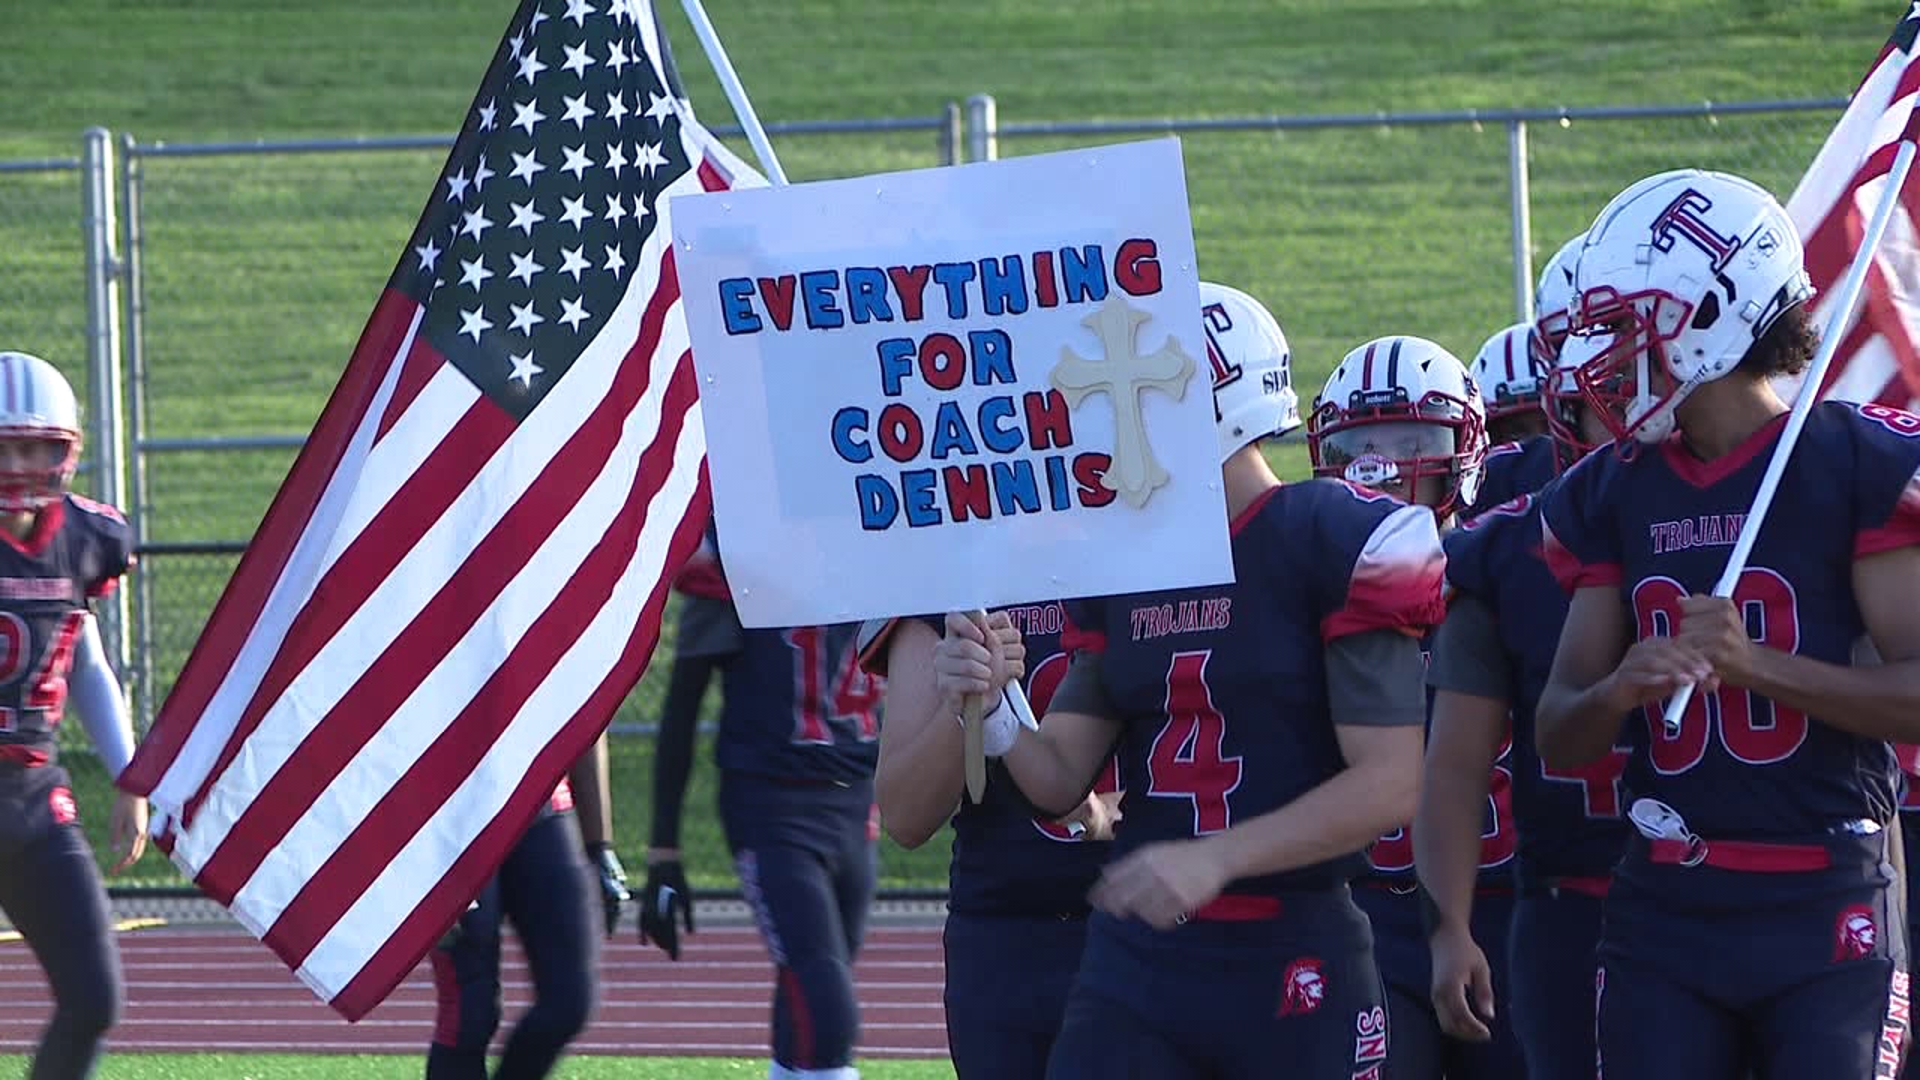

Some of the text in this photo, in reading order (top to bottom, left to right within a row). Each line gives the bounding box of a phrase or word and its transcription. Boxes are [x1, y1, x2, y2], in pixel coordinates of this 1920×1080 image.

[1650, 188, 1741, 275] T
[718, 238, 1162, 335] EVERYTHING
[876, 328, 1017, 396] FOR
[831, 389, 1074, 463] COACH
[855, 452, 1117, 531] DENNIS
[1649, 513, 1749, 554] TROJAN
[1007, 603, 1064, 636] TRO
[1130, 597, 1232, 641] TROJANS
[783, 625, 889, 745] 14
[1146, 648, 1243, 836] 4
